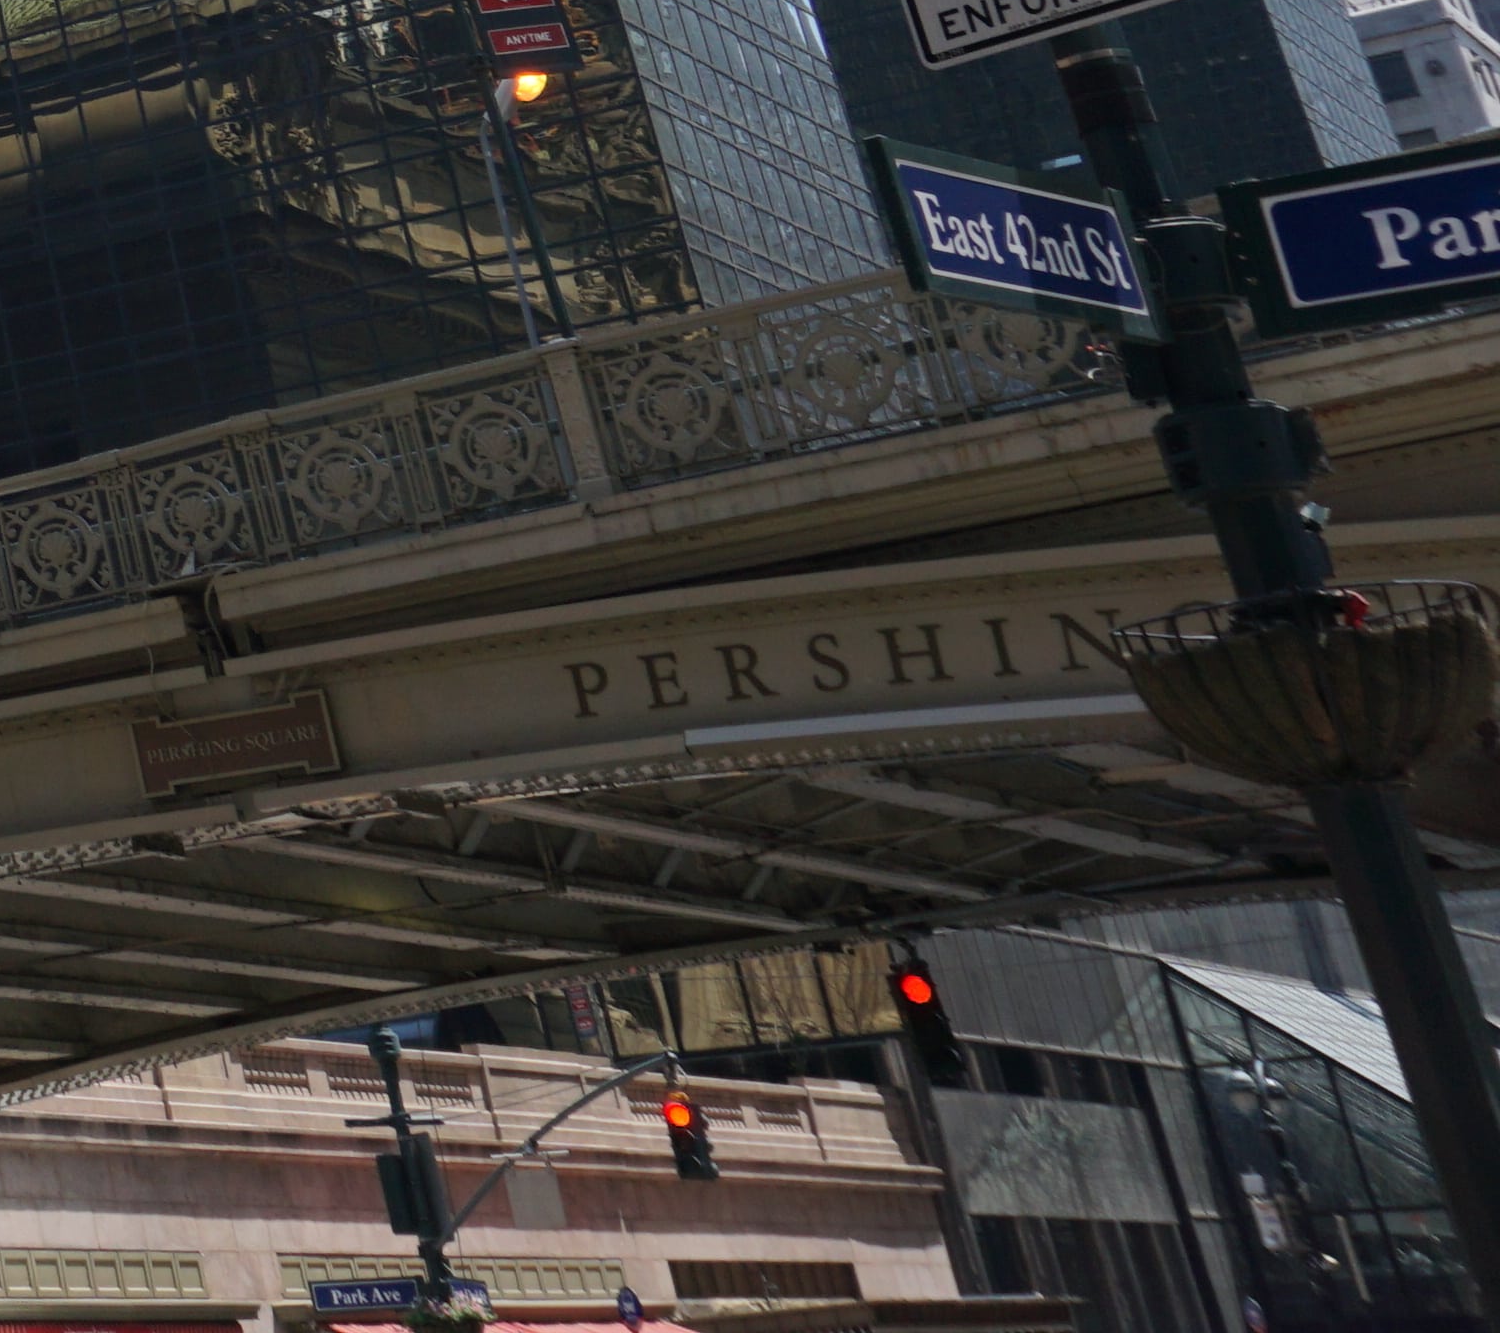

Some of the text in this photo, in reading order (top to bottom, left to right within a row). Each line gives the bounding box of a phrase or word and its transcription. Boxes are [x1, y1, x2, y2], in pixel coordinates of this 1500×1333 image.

[506, 31, 553, 46] ANYTIME
[914, 189, 1132, 291] East 42nd St
[1361, 191, 1500, 270] Par
[244, 723, 322, 752] SQUARE
[331, 1286, 402, 1305] Park Ave
